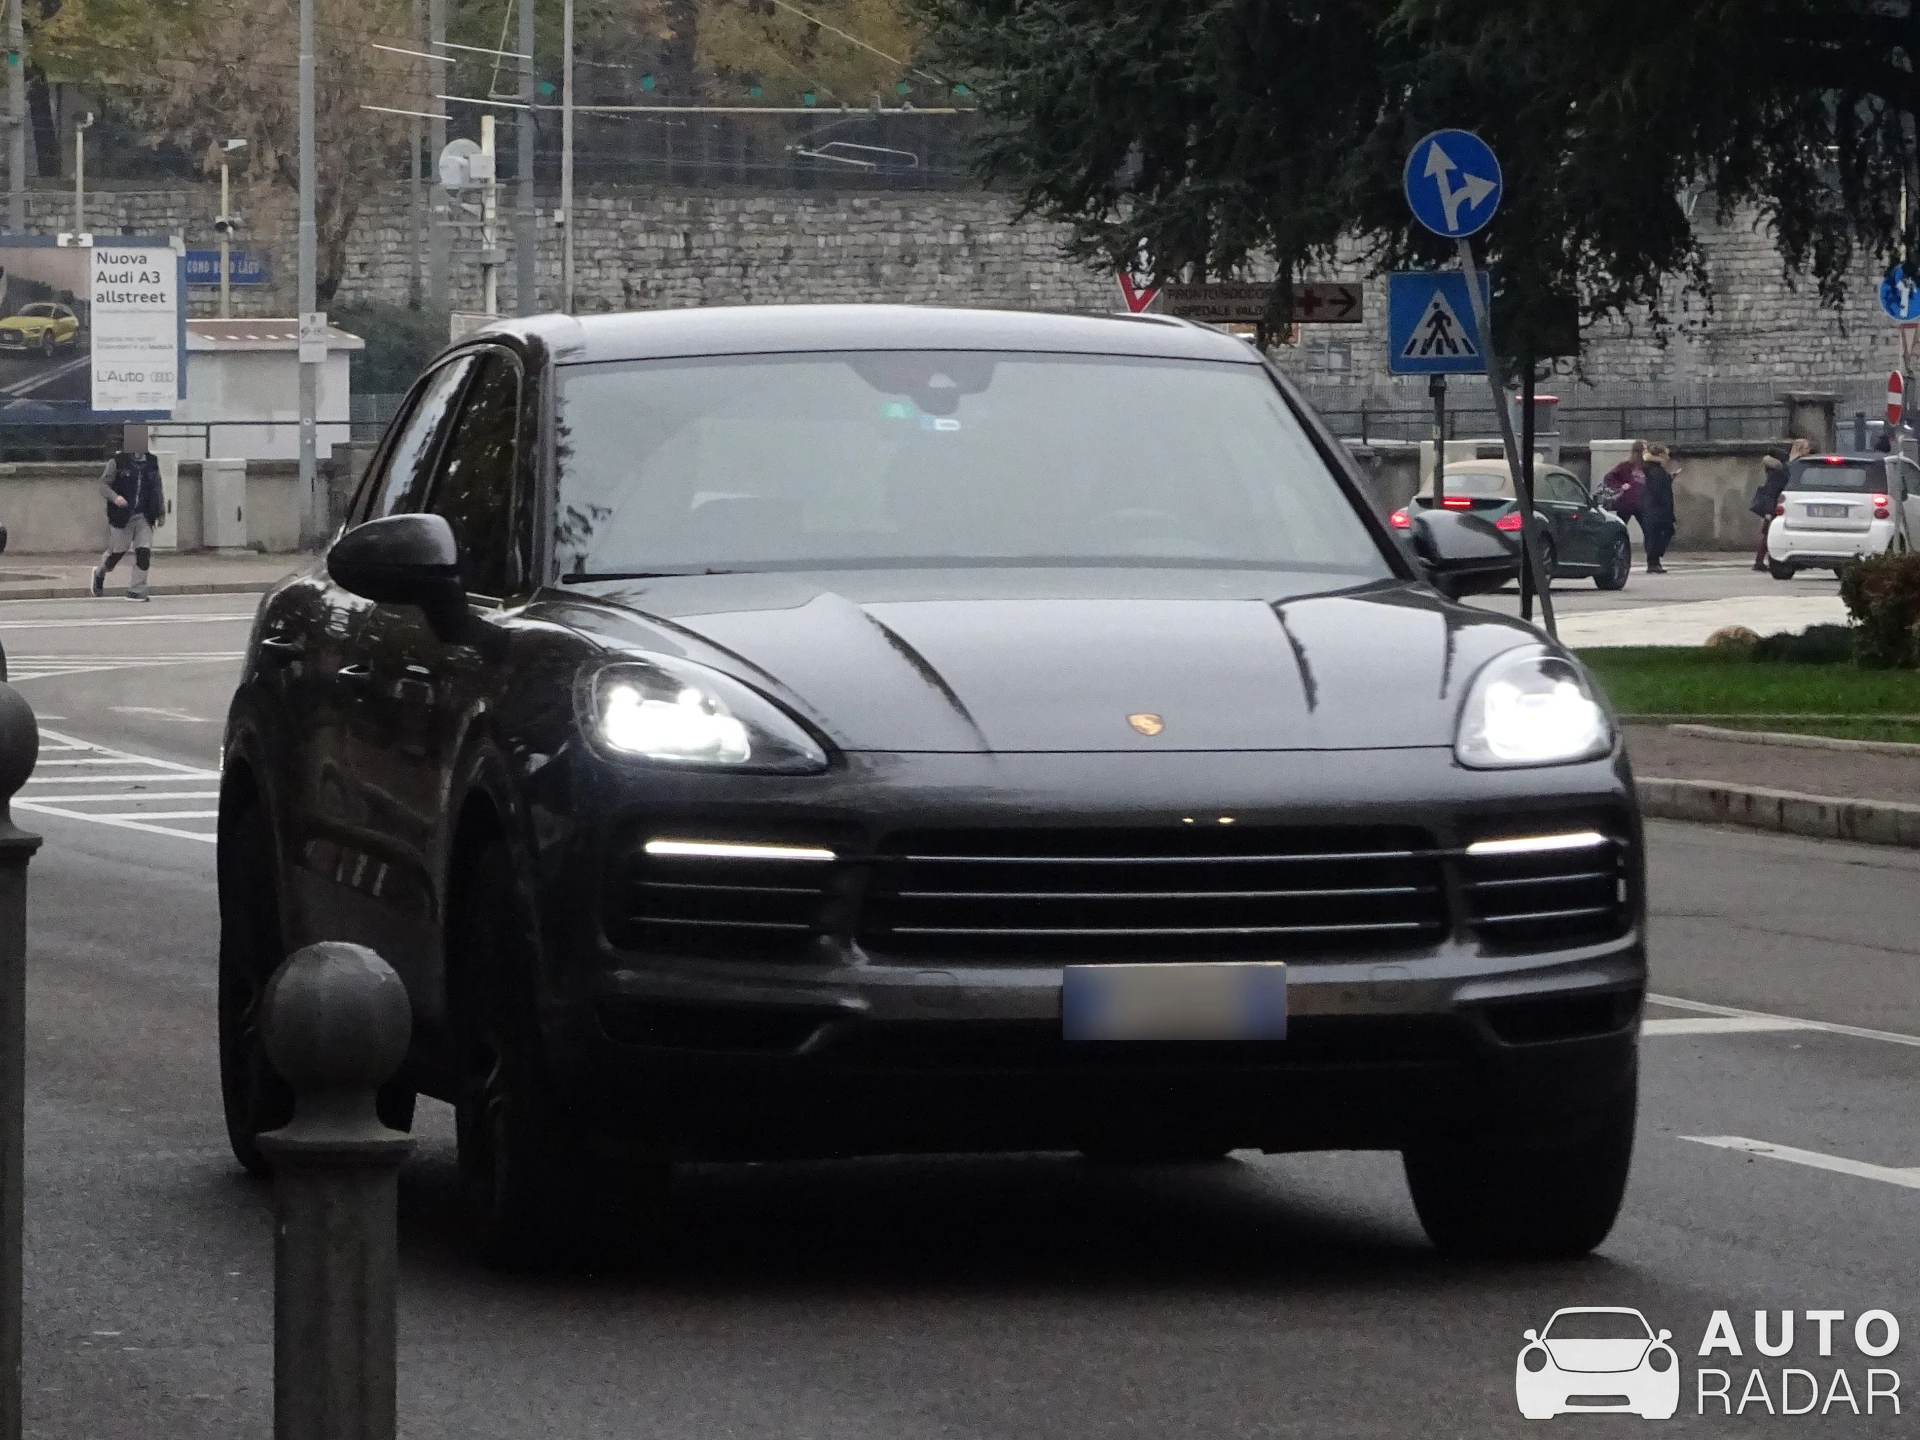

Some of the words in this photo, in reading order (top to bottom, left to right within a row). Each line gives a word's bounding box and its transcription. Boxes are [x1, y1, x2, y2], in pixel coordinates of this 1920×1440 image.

[96, 251, 148, 265] Nuova
[96, 270, 134, 284] Audi
[138, 270, 161, 284] A3
[96, 290, 167, 303] allstreet
[97, 370, 145, 383] L'Auto
